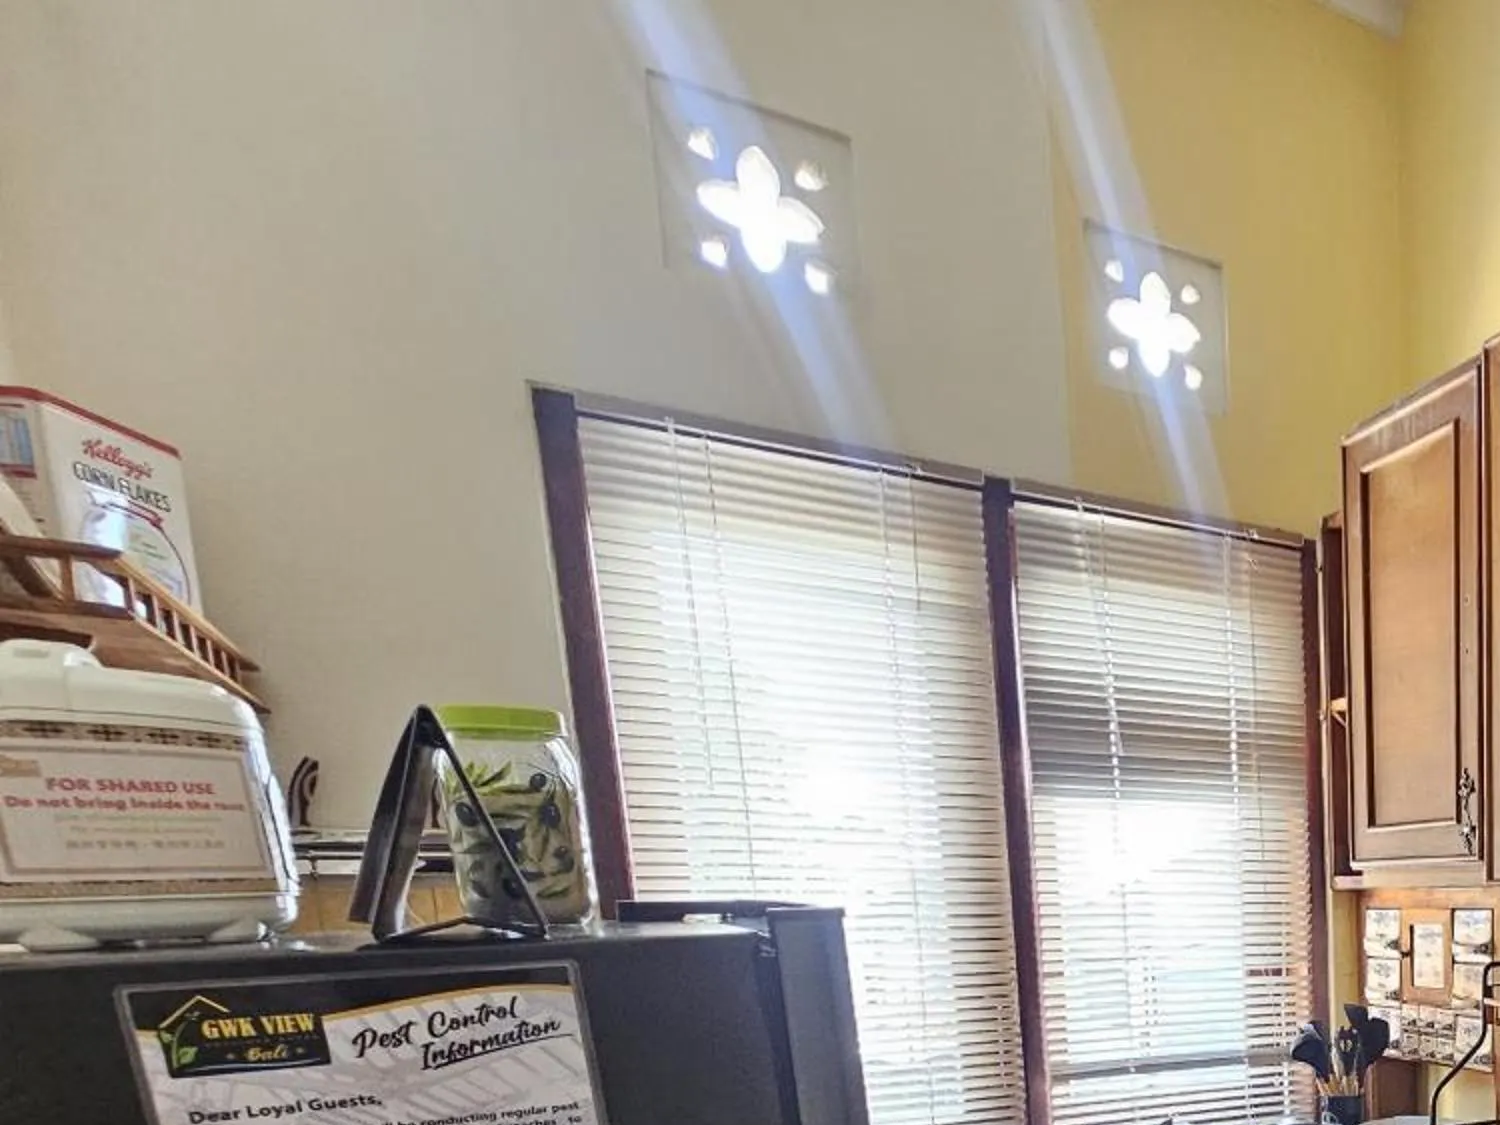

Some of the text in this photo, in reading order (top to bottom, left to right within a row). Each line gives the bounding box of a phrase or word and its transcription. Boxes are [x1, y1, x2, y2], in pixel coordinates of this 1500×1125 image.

[82, 439, 153, 480] Kellogg's
[72, 461, 171, 512] CORN FLAKES
[46, 778, 216, 795] FOR SHARED USE
[4, 796, 33, 807] Do
[37, 798, 70, 808] not
[201, 1013, 314, 1039] GWK VIEW
[352, 996, 519, 1057] Pest Control
[244, 1043, 289, 1061] Bali
[420, 1019, 561, 1070] Information
[188, 1094, 382, 1125] Dear Loyal Guests,
[501, 1105, 547, 1120] regular
[552, 1101, 579, 1115] pest
[567, 1115, 582, 1124] to
